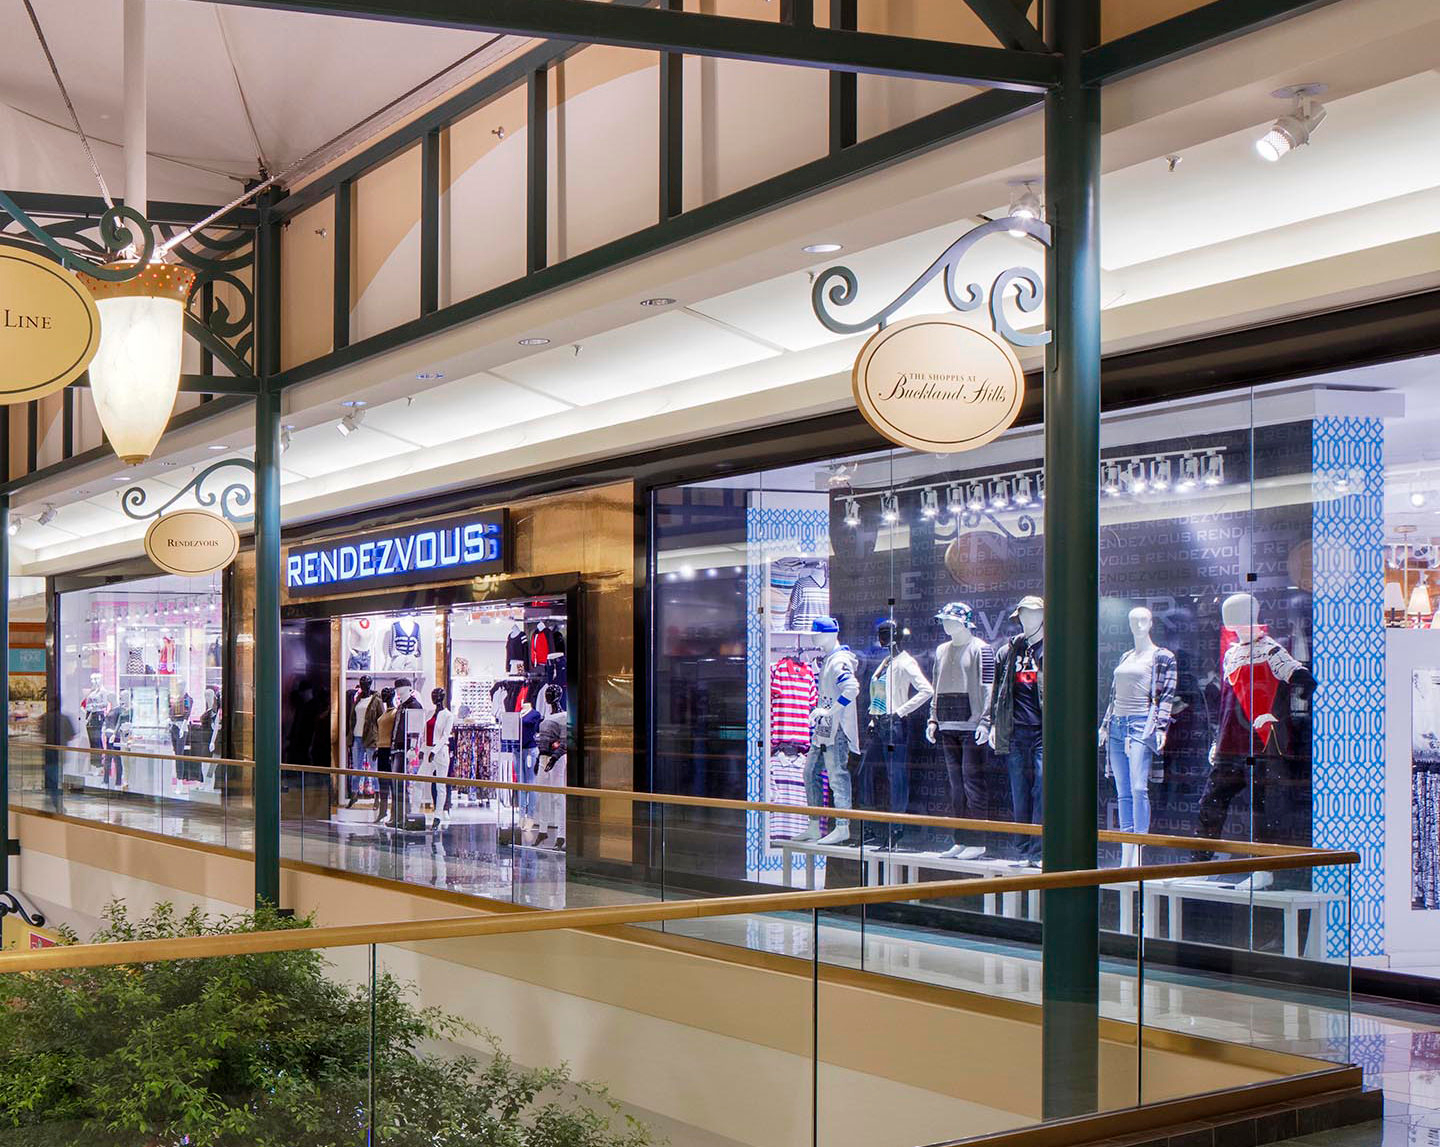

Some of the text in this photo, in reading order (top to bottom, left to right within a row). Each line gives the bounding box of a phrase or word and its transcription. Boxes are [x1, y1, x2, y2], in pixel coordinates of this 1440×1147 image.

[4, 309, 52, 330] LINE
[878, 372, 1006, 404] Buckland Hills
[928, 374, 964, 382] SHOPPES
[167, 539, 219, 547] RENDEZVOUS
[288, 523, 485, 587] RENDEZVOUS
